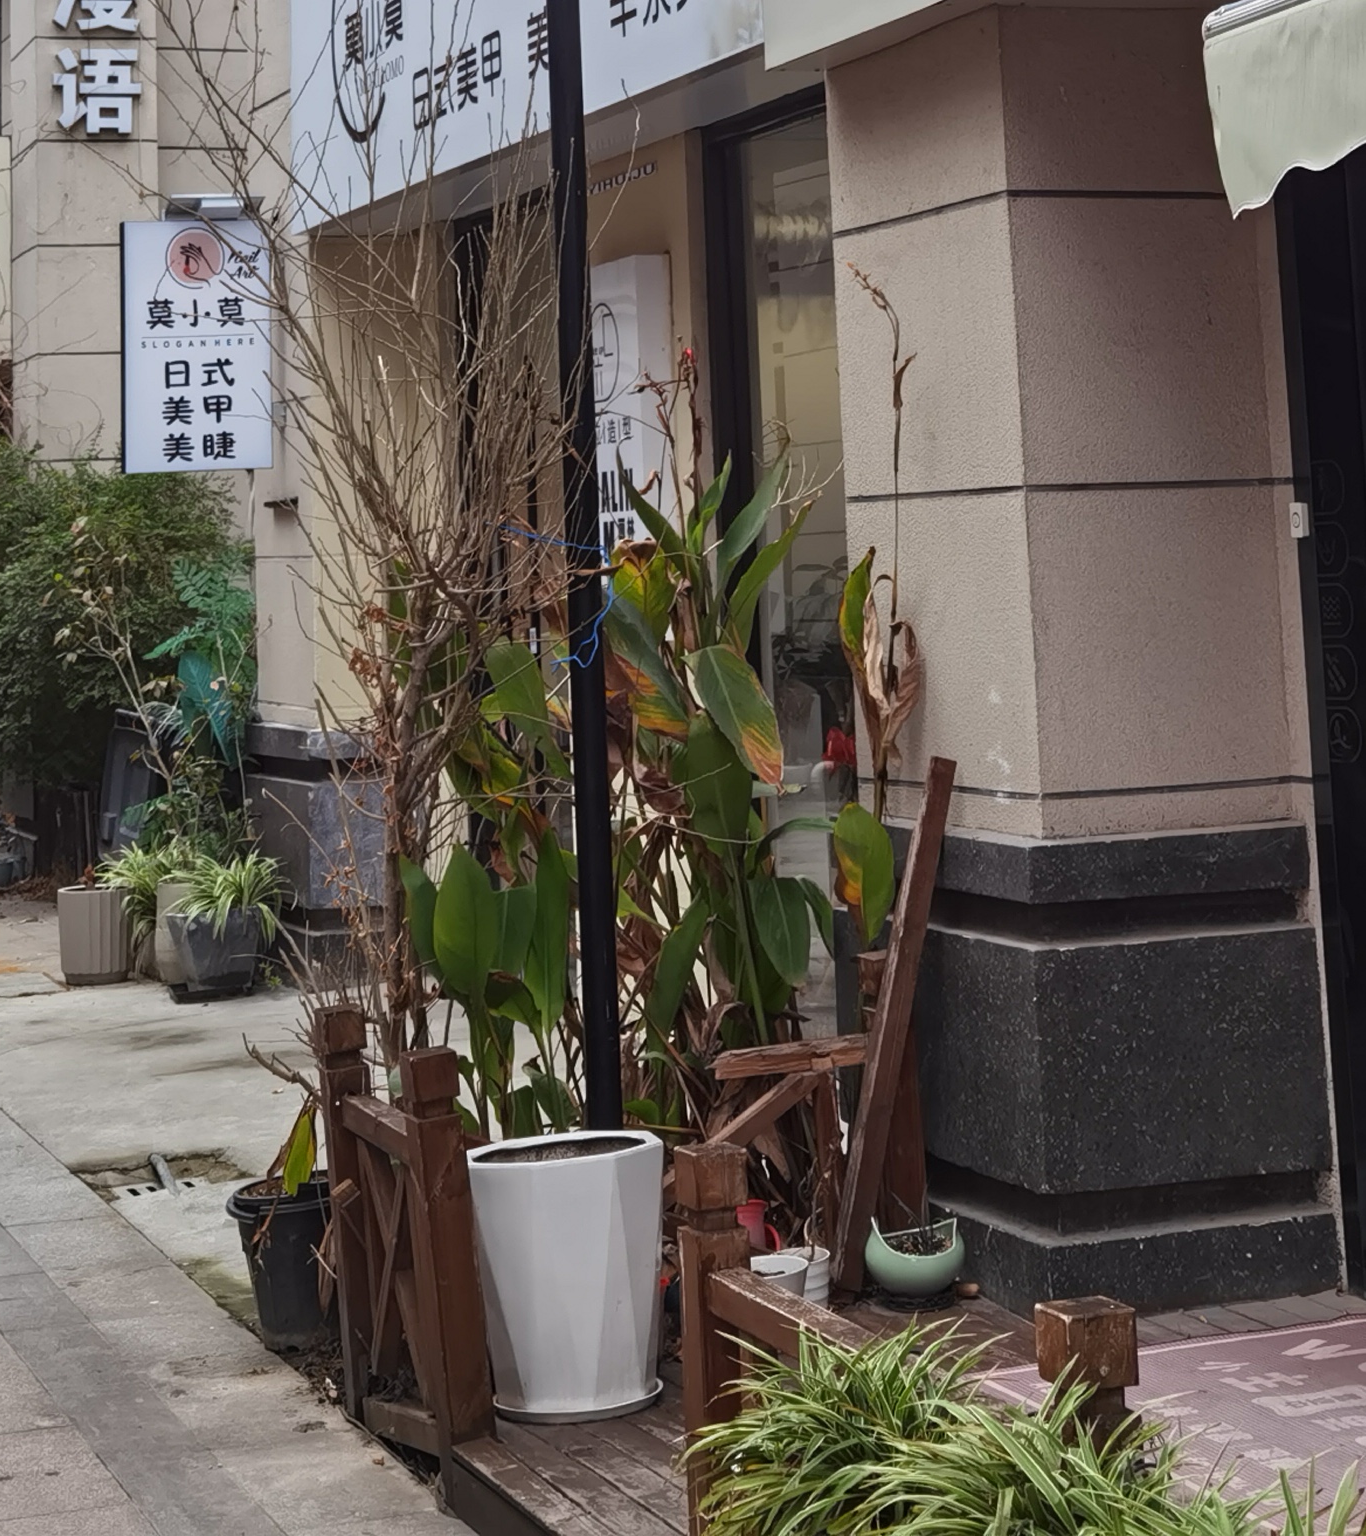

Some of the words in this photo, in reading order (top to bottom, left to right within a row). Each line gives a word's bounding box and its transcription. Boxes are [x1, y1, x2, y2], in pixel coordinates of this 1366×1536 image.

[413, 29, 502, 131] 日式美甲
[146, 297, 246, 329] 莫小莫
[141, 340, 207, 349] SLOGAN
[214, 337, 255, 347] HERE
[165, 358, 235, 389] 日式
[162, 395, 233, 426] 美甲
[162, 431, 237, 462] 美睫
